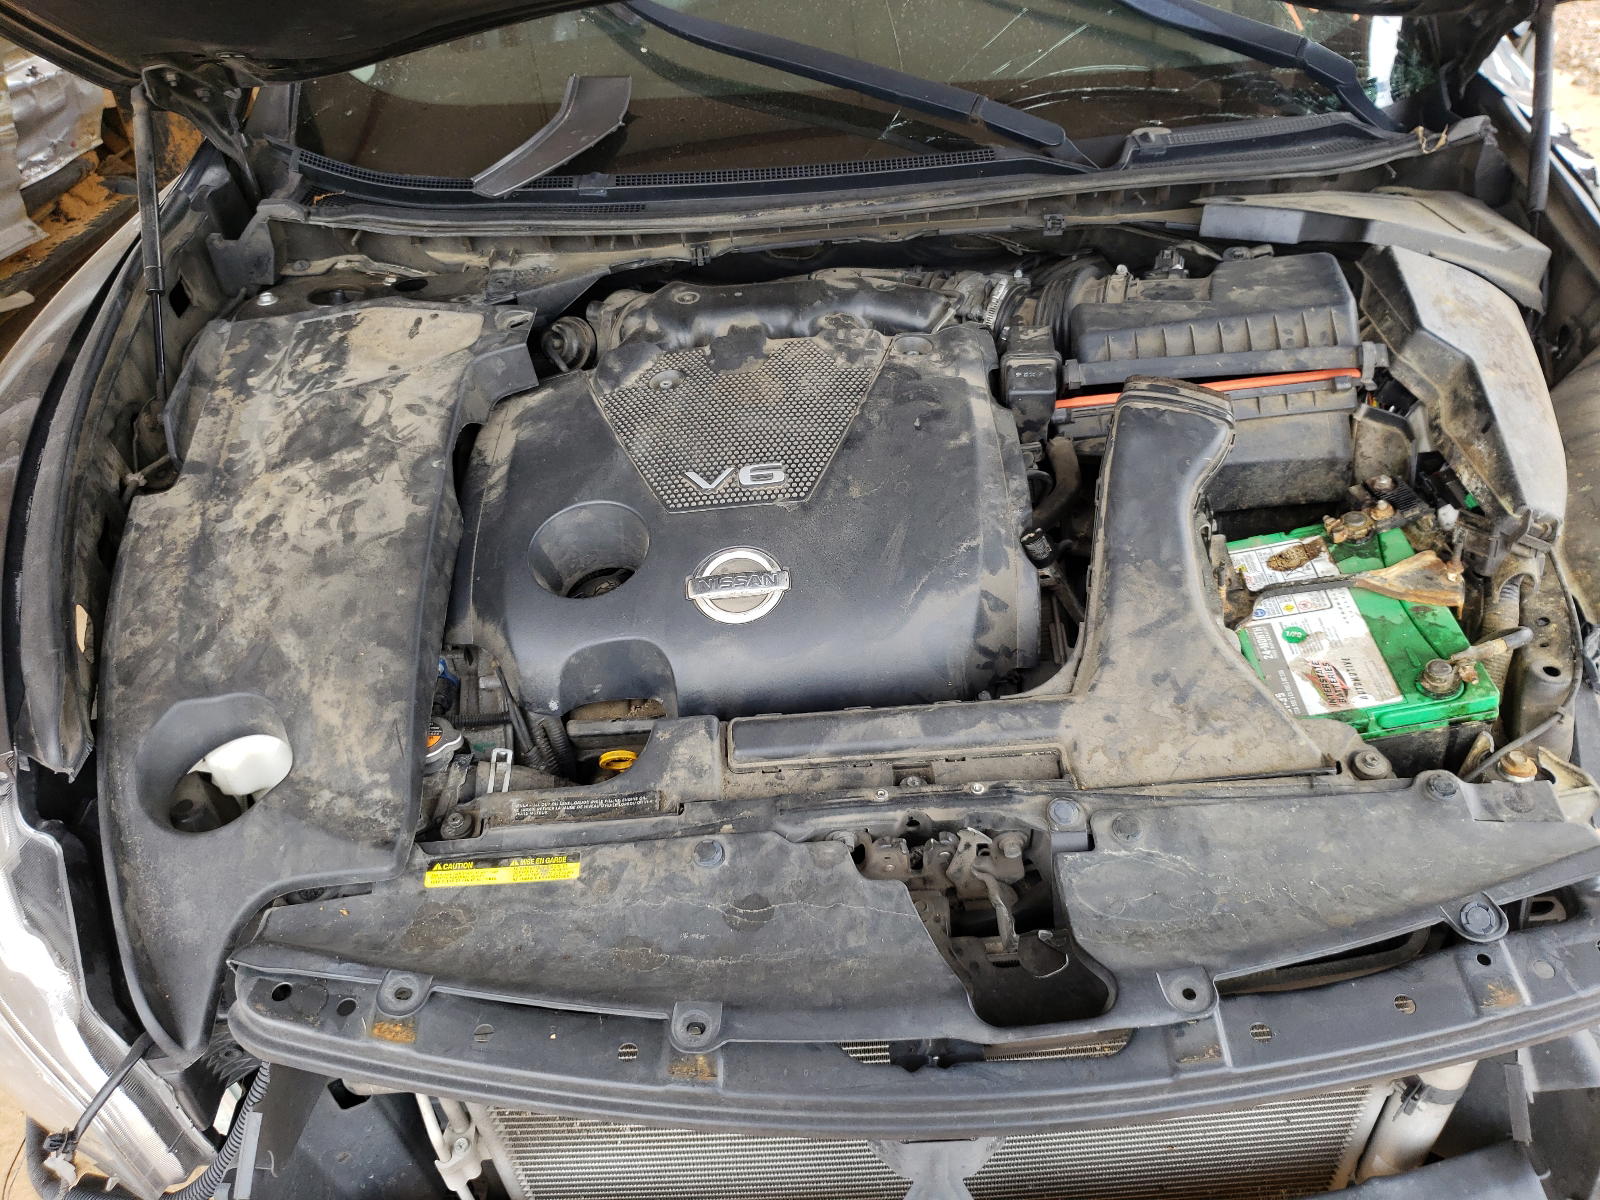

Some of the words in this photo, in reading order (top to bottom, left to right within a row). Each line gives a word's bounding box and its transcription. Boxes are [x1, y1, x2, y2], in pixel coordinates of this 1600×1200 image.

[683, 463, 786, 490] V6
[698, 572, 779, 591] NISSAN
[1310, 660, 1338, 707] INTERSTATE
[1322, 662, 1348, 705] BATTERIES
[1340, 658, 1369, 700] AUTOMOTIVE
[442, 861, 474, 870] CAUTION
[520, 858, 535, 866] MISE
[535, 857, 544, 865] EN
[545, 855, 567, 864] GARDE
